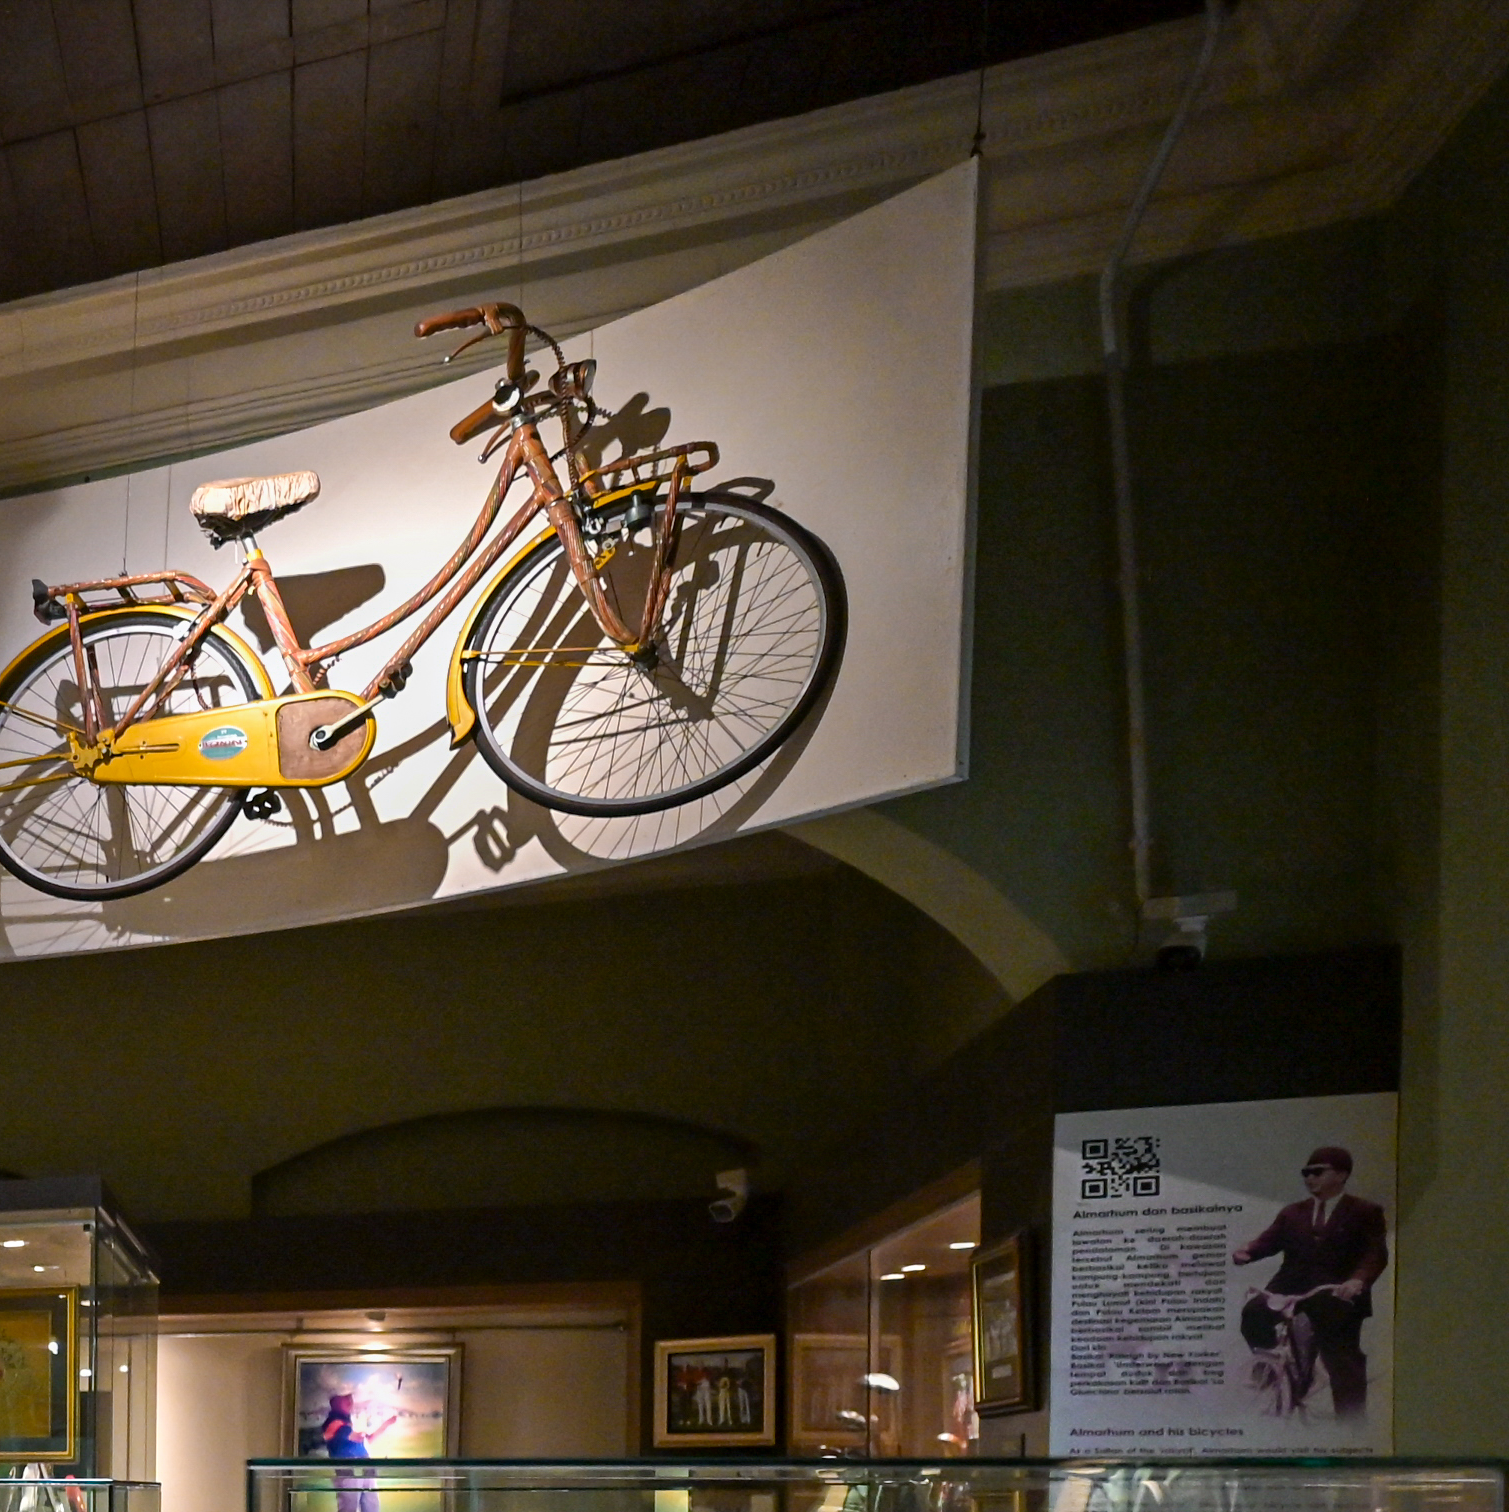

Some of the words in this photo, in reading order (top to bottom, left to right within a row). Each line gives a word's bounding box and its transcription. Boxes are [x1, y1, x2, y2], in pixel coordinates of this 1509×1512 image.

[1072, 1208, 1139, 1220] Almarhum
[1142, 1208, 1168, 1218] dan
[1172, 1204, 1243, 1215] basikalnya
